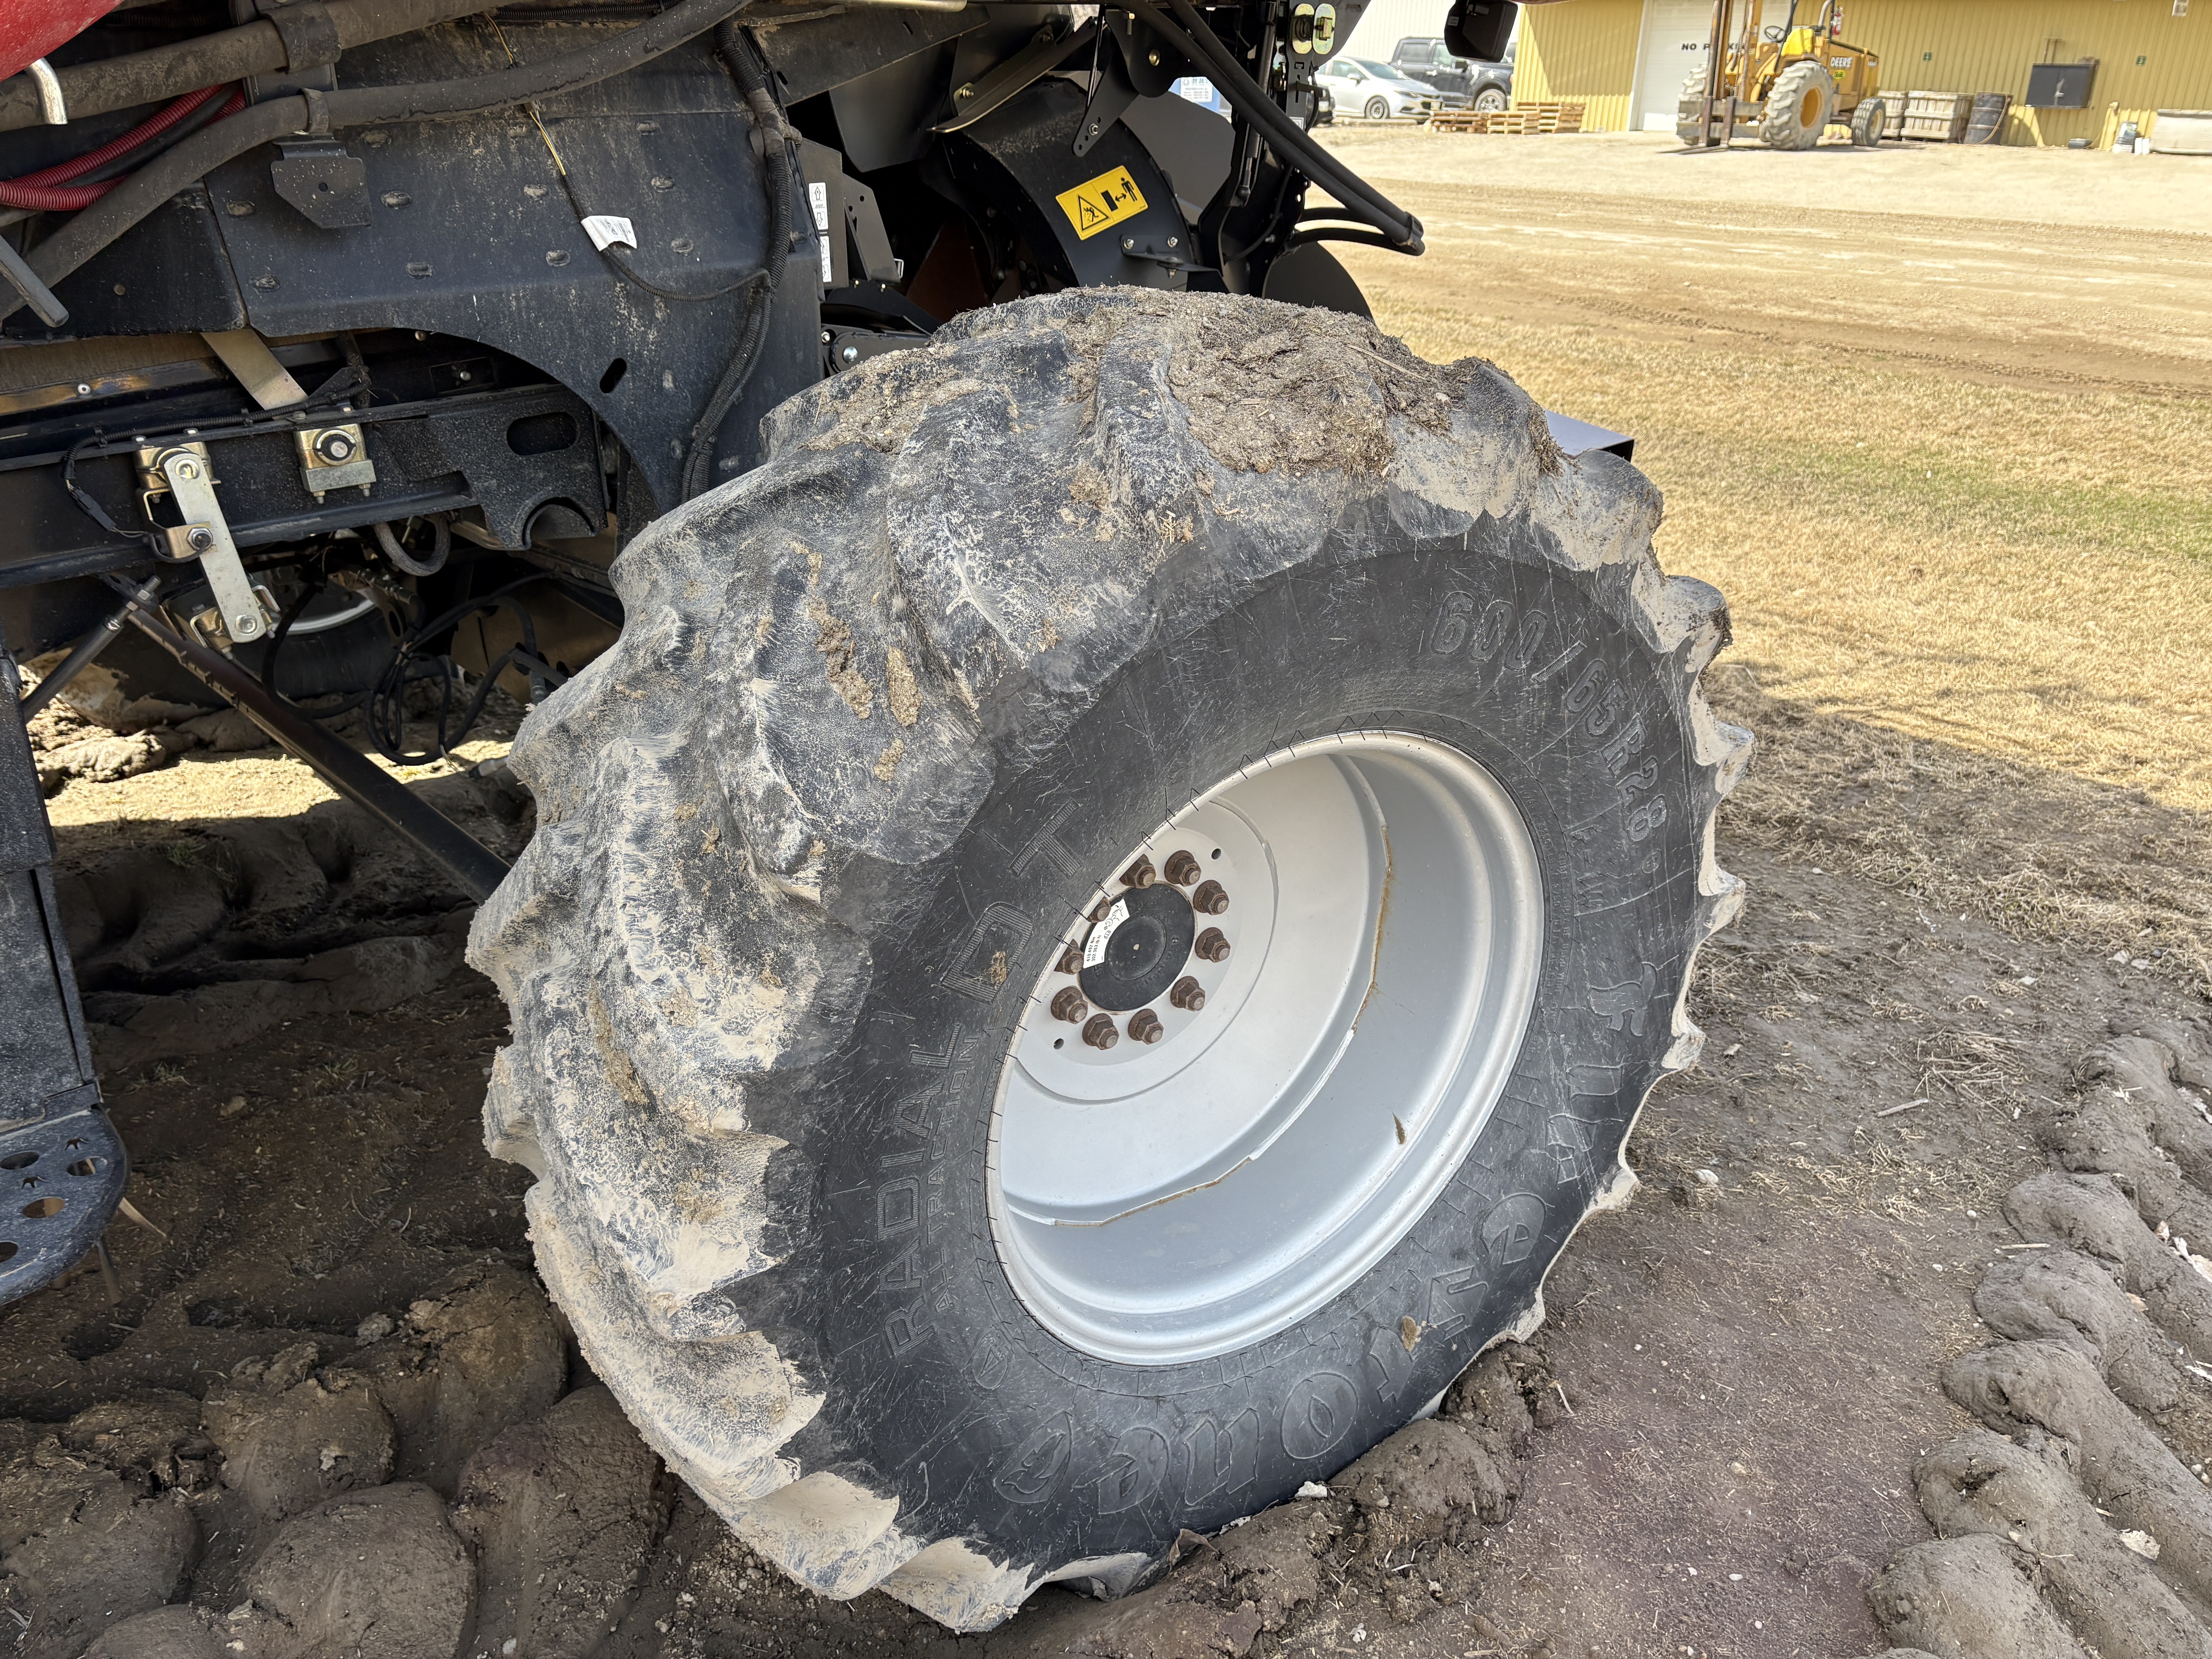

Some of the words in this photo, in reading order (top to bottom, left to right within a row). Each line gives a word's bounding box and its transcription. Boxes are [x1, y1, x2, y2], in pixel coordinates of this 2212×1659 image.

[1830, 57, 1853, 68] DEERE
[875, 1022, 962, 1359] RADIAL
[926, 1037, 979, 1245] TRACTION
[929, 1251, 955, 1313] ALL
